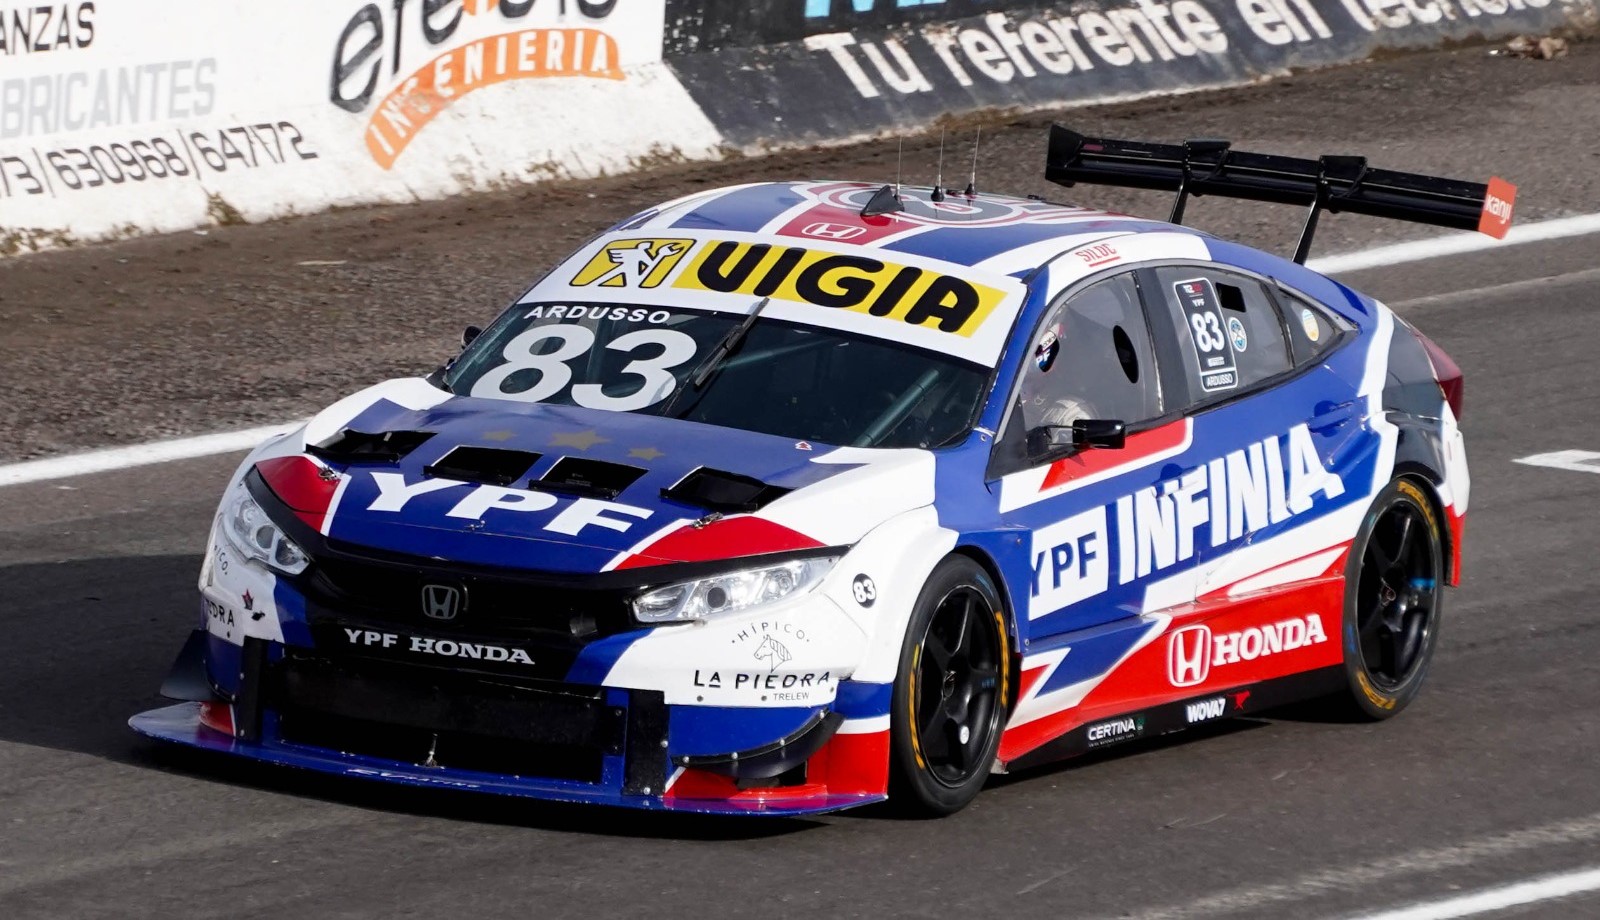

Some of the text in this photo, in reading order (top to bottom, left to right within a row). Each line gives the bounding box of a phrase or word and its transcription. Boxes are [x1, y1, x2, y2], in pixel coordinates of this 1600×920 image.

[804, 32, 933, 98] Tu
[922, 0, 1227, 87] referente
[1484, 194, 1512, 224] kanji
[524, 304, 670, 325] ARDUSSO
[1191, 311, 1225, 352] 83
[470, 324, 697, 412] 83
[366, 471, 655, 536] YPF
[1117, 423, 1345, 586] INFINIA
[852, 579, 877, 604] 83
[344, 629, 536, 665] YPF HONDA
[1212, 613, 1328, 667] HONDA
[735, 671, 830, 689] PIEDRA
[773, 692, 810, 701] TRELEW
[1088, 718, 1136, 741] CERTINA
